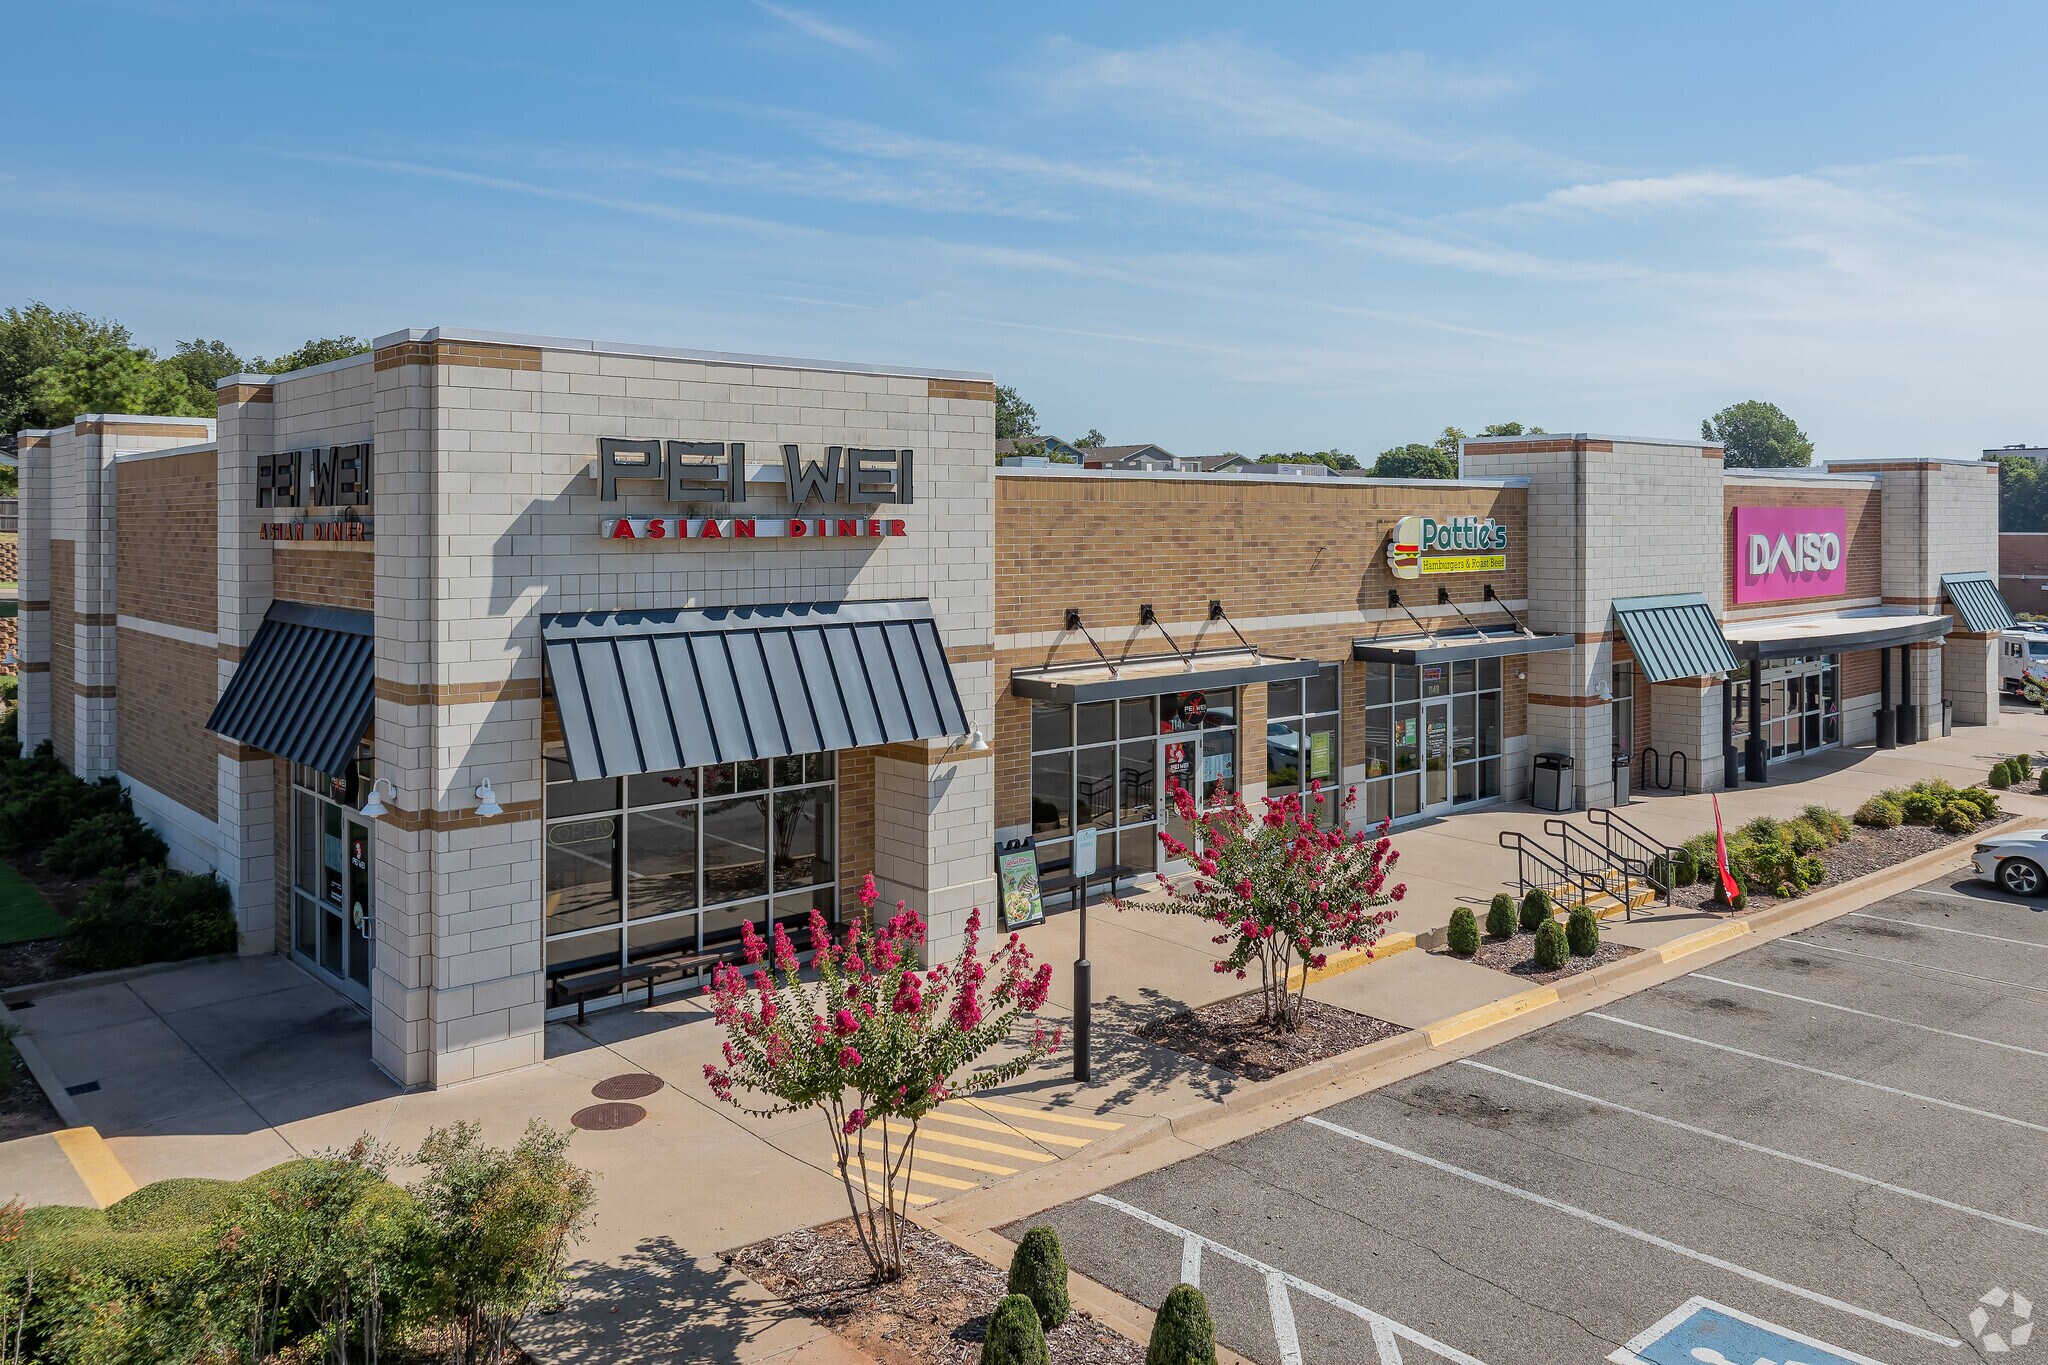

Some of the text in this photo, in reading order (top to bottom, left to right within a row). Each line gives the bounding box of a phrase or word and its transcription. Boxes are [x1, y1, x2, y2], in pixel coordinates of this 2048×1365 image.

[256, 443, 374, 508] PEI WEI
[597, 438, 914, 505] PEI WEI
[259, 521, 366, 542] ASIAN DINER
[611, 518, 908, 540] ASIAN DINER
[1420, 515, 1507, 550] Pattie's
[1422, 557, 1505, 572] Hamburgers & Roast Beef
[1749, 532, 1840, 575] DAISO
[1428, 685, 1440, 696] 1149
[558, 821, 608, 841] OPEN
